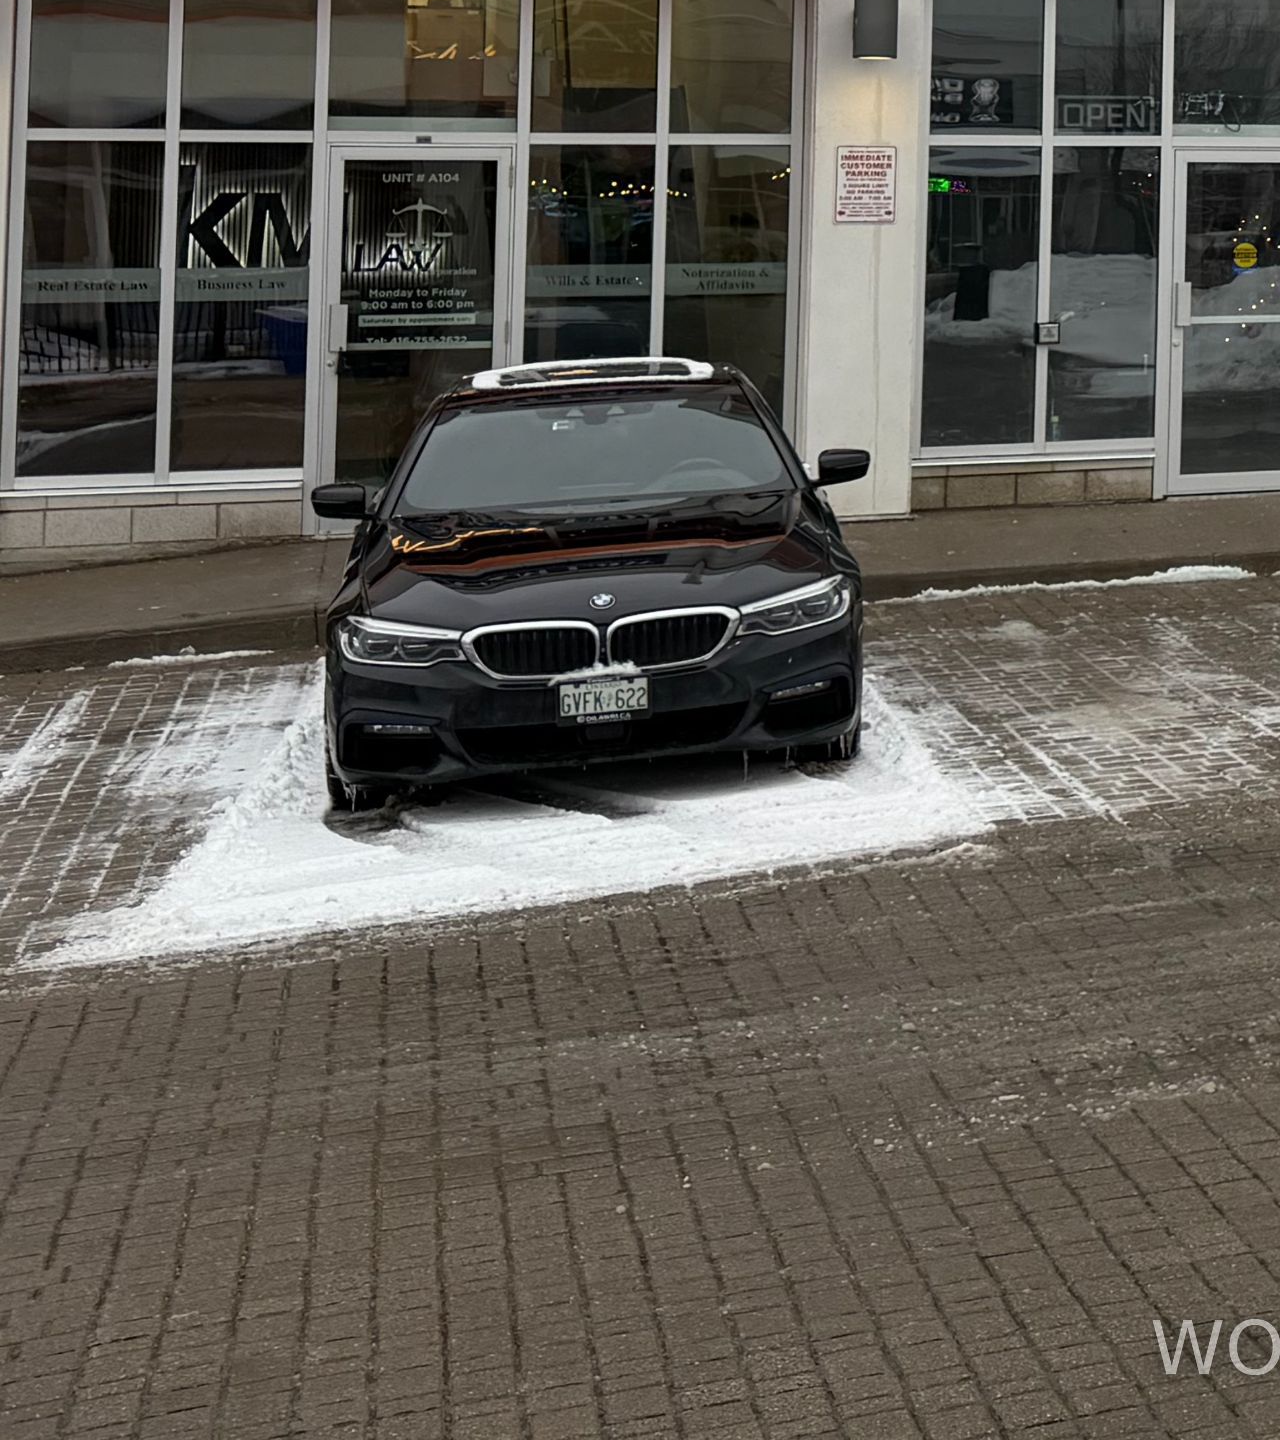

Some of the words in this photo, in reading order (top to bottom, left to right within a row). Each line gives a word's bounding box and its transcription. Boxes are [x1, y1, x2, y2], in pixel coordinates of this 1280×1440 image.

[1063, 102, 1146, 128] OPEN
[840, 154, 893, 162] IMMEDIATE
[382, 173, 413, 183] UNIT
[416, 173, 425, 183] #
[428, 173, 460, 183] A104
[352, 243, 443, 272] LAW
[682, 268, 756, 279] Notarization
[759, 268, 769, 278] &
[38, 280, 69, 292] Real
[74, 280, 116, 292] Estate
[120, 280, 149, 291] Law
[197, 279, 252, 290] Business
[258, 279, 287, 289] Law
[546, 275, 576, 287] Wills
[579, 275, 591, 286] &
[696, 280, 756, 290] Affidavits
[369, 288, 413, 300] Monday
[416, 288, 428, 298] to
[431, 287, 467, 299] Friday
[361, 300, 388, 310] 9:00
[390, 301, 408, 309] am
[411, 300, 424, 309] to
[427, 298, 454, 309] 6:00
[456, 300, 475, 311] pm
[561, 690, 604, 715] GVFK
[615, 686, 647, 709] 622
